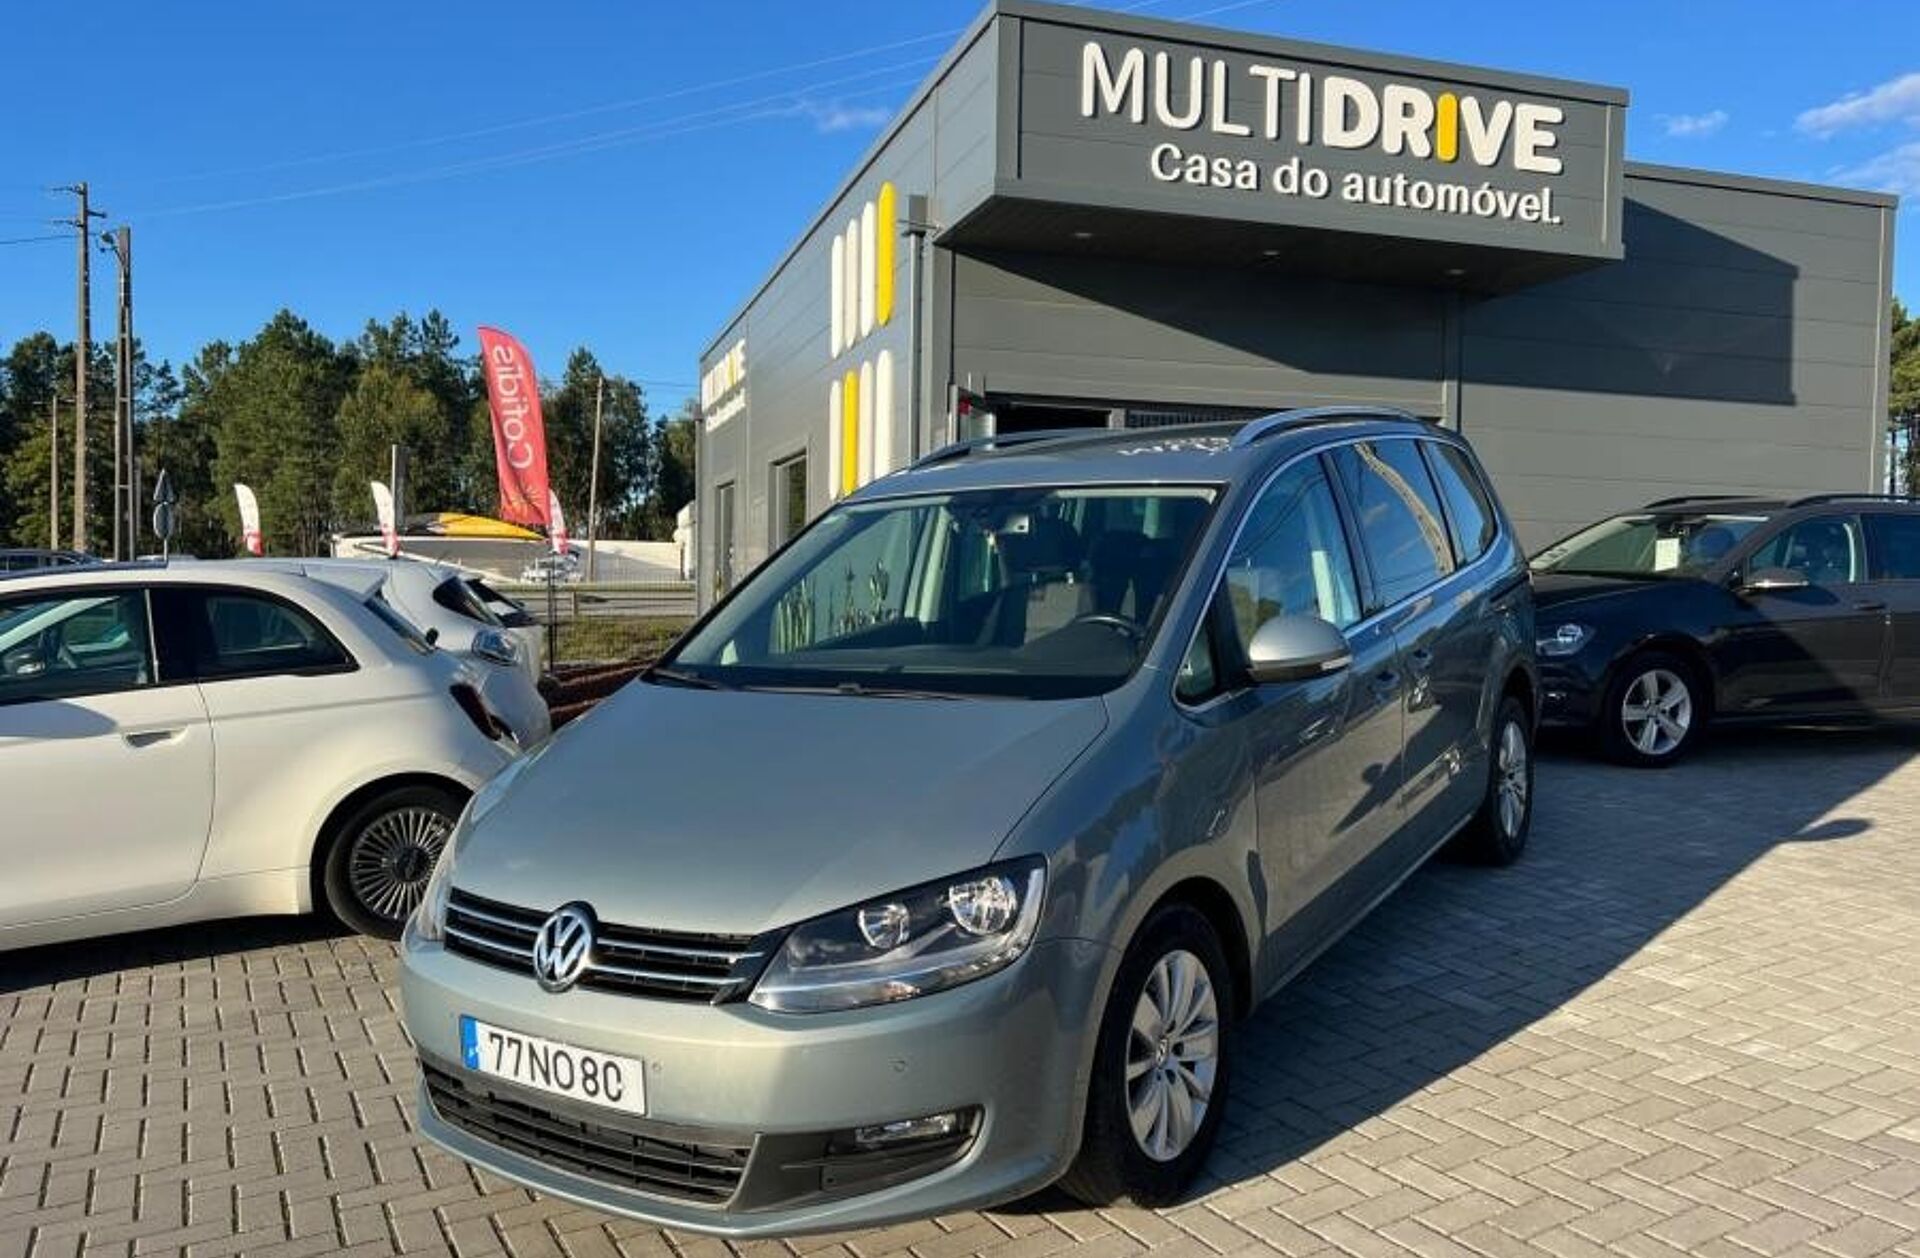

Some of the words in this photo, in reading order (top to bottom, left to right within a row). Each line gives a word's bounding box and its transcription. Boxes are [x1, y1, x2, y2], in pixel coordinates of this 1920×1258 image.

[1082, 42, 1564, 174] MULTIDRIVE
[1151, 143, 1258, 190] Casa
[1273, 157, 1330, 198] do
[1342, 172, 1562, 224] automóvel.
